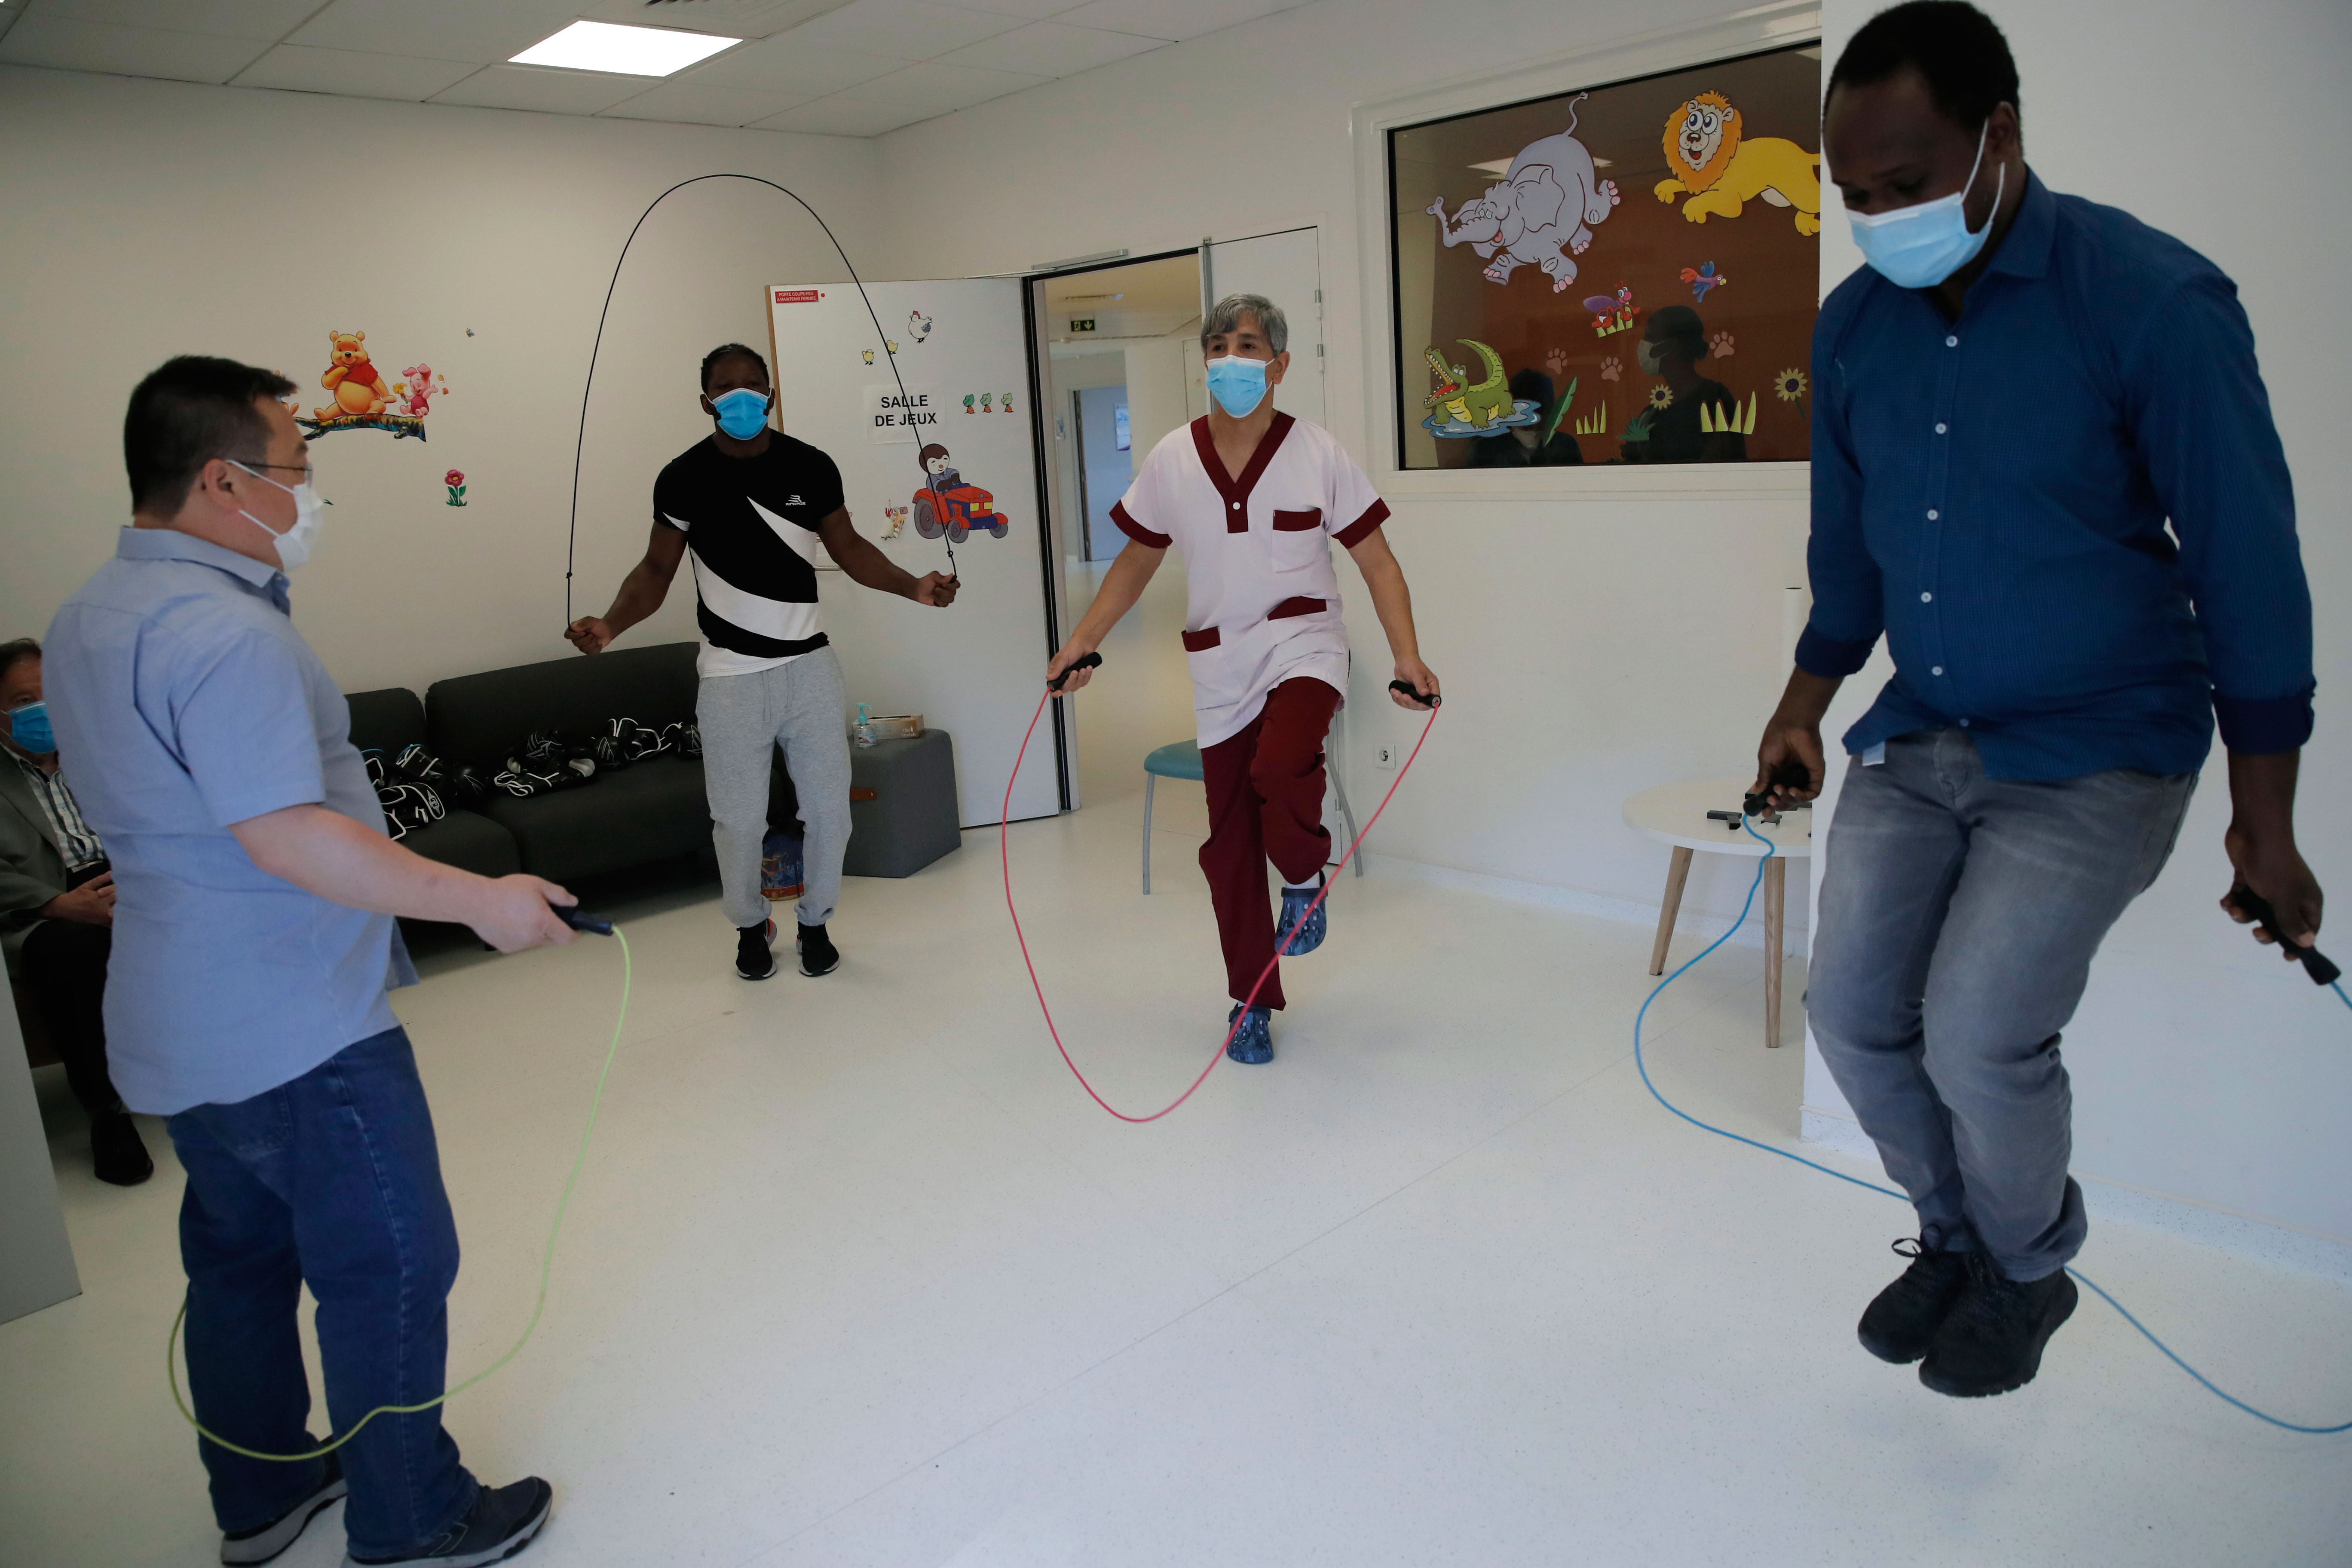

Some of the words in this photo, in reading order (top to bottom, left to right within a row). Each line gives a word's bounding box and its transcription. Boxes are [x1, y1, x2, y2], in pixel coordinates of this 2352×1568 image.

[881, 395, 928, 408] SALLE
[875, 415, 894, 427] DE
[899, 413, 937, 426] JEUX
